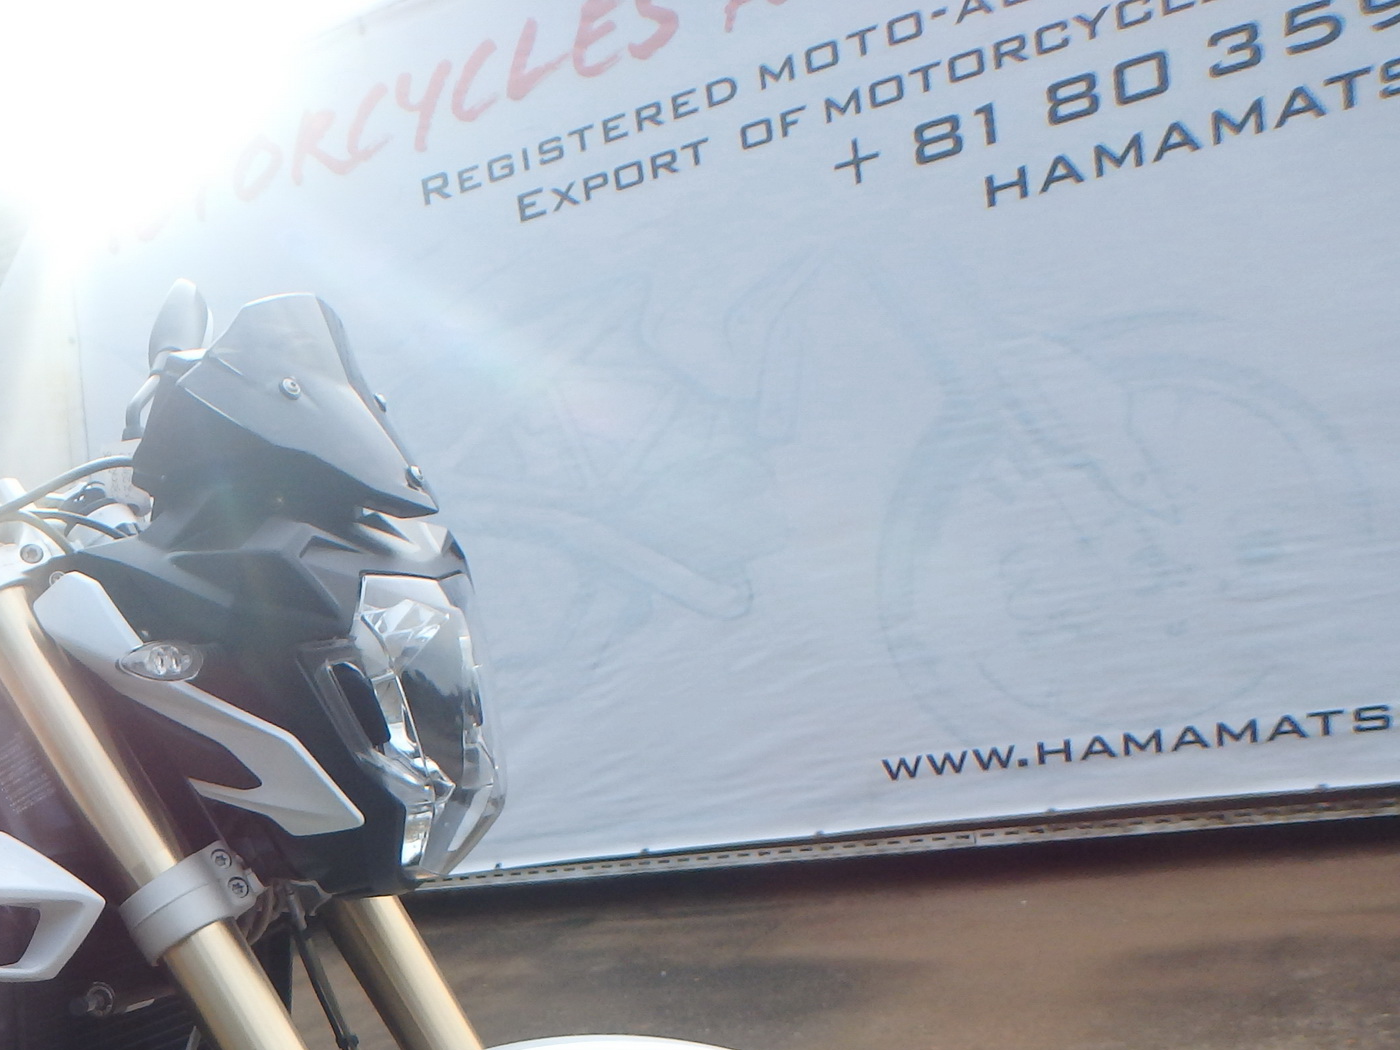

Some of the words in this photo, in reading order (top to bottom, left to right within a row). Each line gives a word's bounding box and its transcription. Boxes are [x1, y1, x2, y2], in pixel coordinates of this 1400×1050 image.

[110, 0, 679, 253] ORCYCLES
[420, 77, 738, 206] REGISTERED
[758, 0, 1032, 91] MOTO-A
[517, 137, 709, 223] EXPORT
[740, 105, 807, 150] OF
[825, 0, 1216, 123] MOTORCYCL
[833, 138, 880, 185] +
[913, 102, 998, 165] 81
[1046, 50, 1171, 126] 80
[881, 704, 1393, 780] WWW.HAMAMATS
